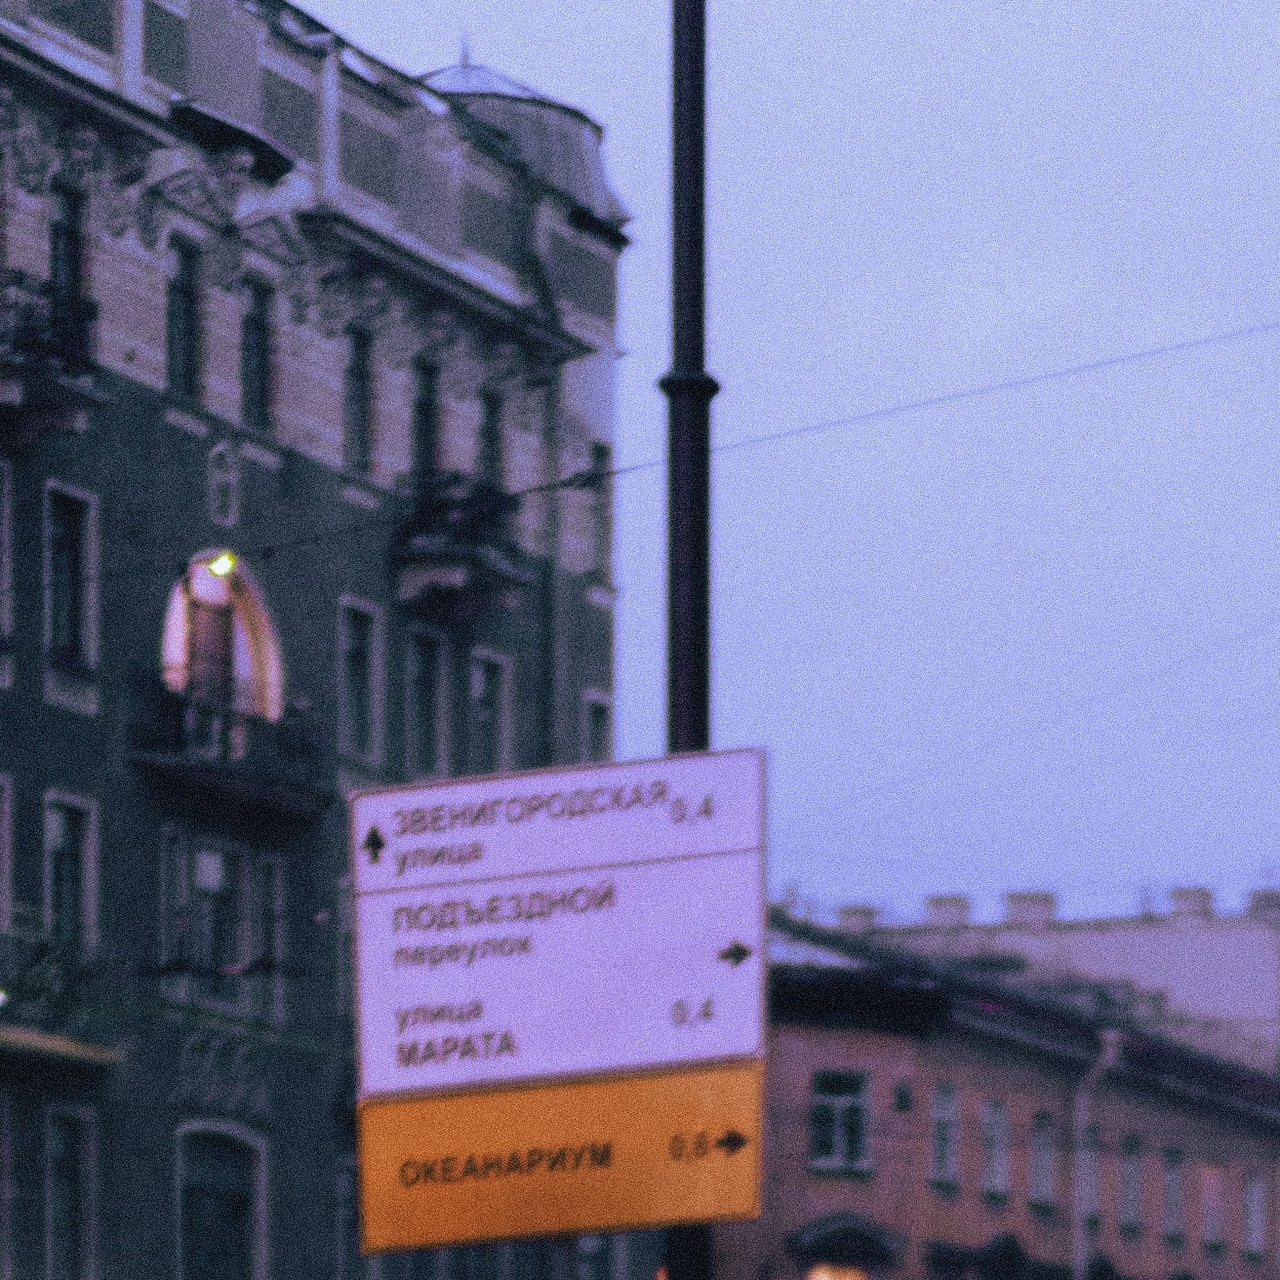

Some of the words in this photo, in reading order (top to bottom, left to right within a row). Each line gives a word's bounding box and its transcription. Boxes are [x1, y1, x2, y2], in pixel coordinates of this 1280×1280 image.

[394, 781, 668, 836] ЗВЕНИГОРОДСКАЯ
[395, 842, 483, 877] улица
[394, 881, 615, 931] ПОДЪЕЗДНОЙ
[393, 936, 532, 969] переулок
[396, 1000, 484, 1034] улица
[397, 1032, 517, 1068] МАРАТА
[399, 1140, 614, 1188] ОКЕАНАРИУМ
